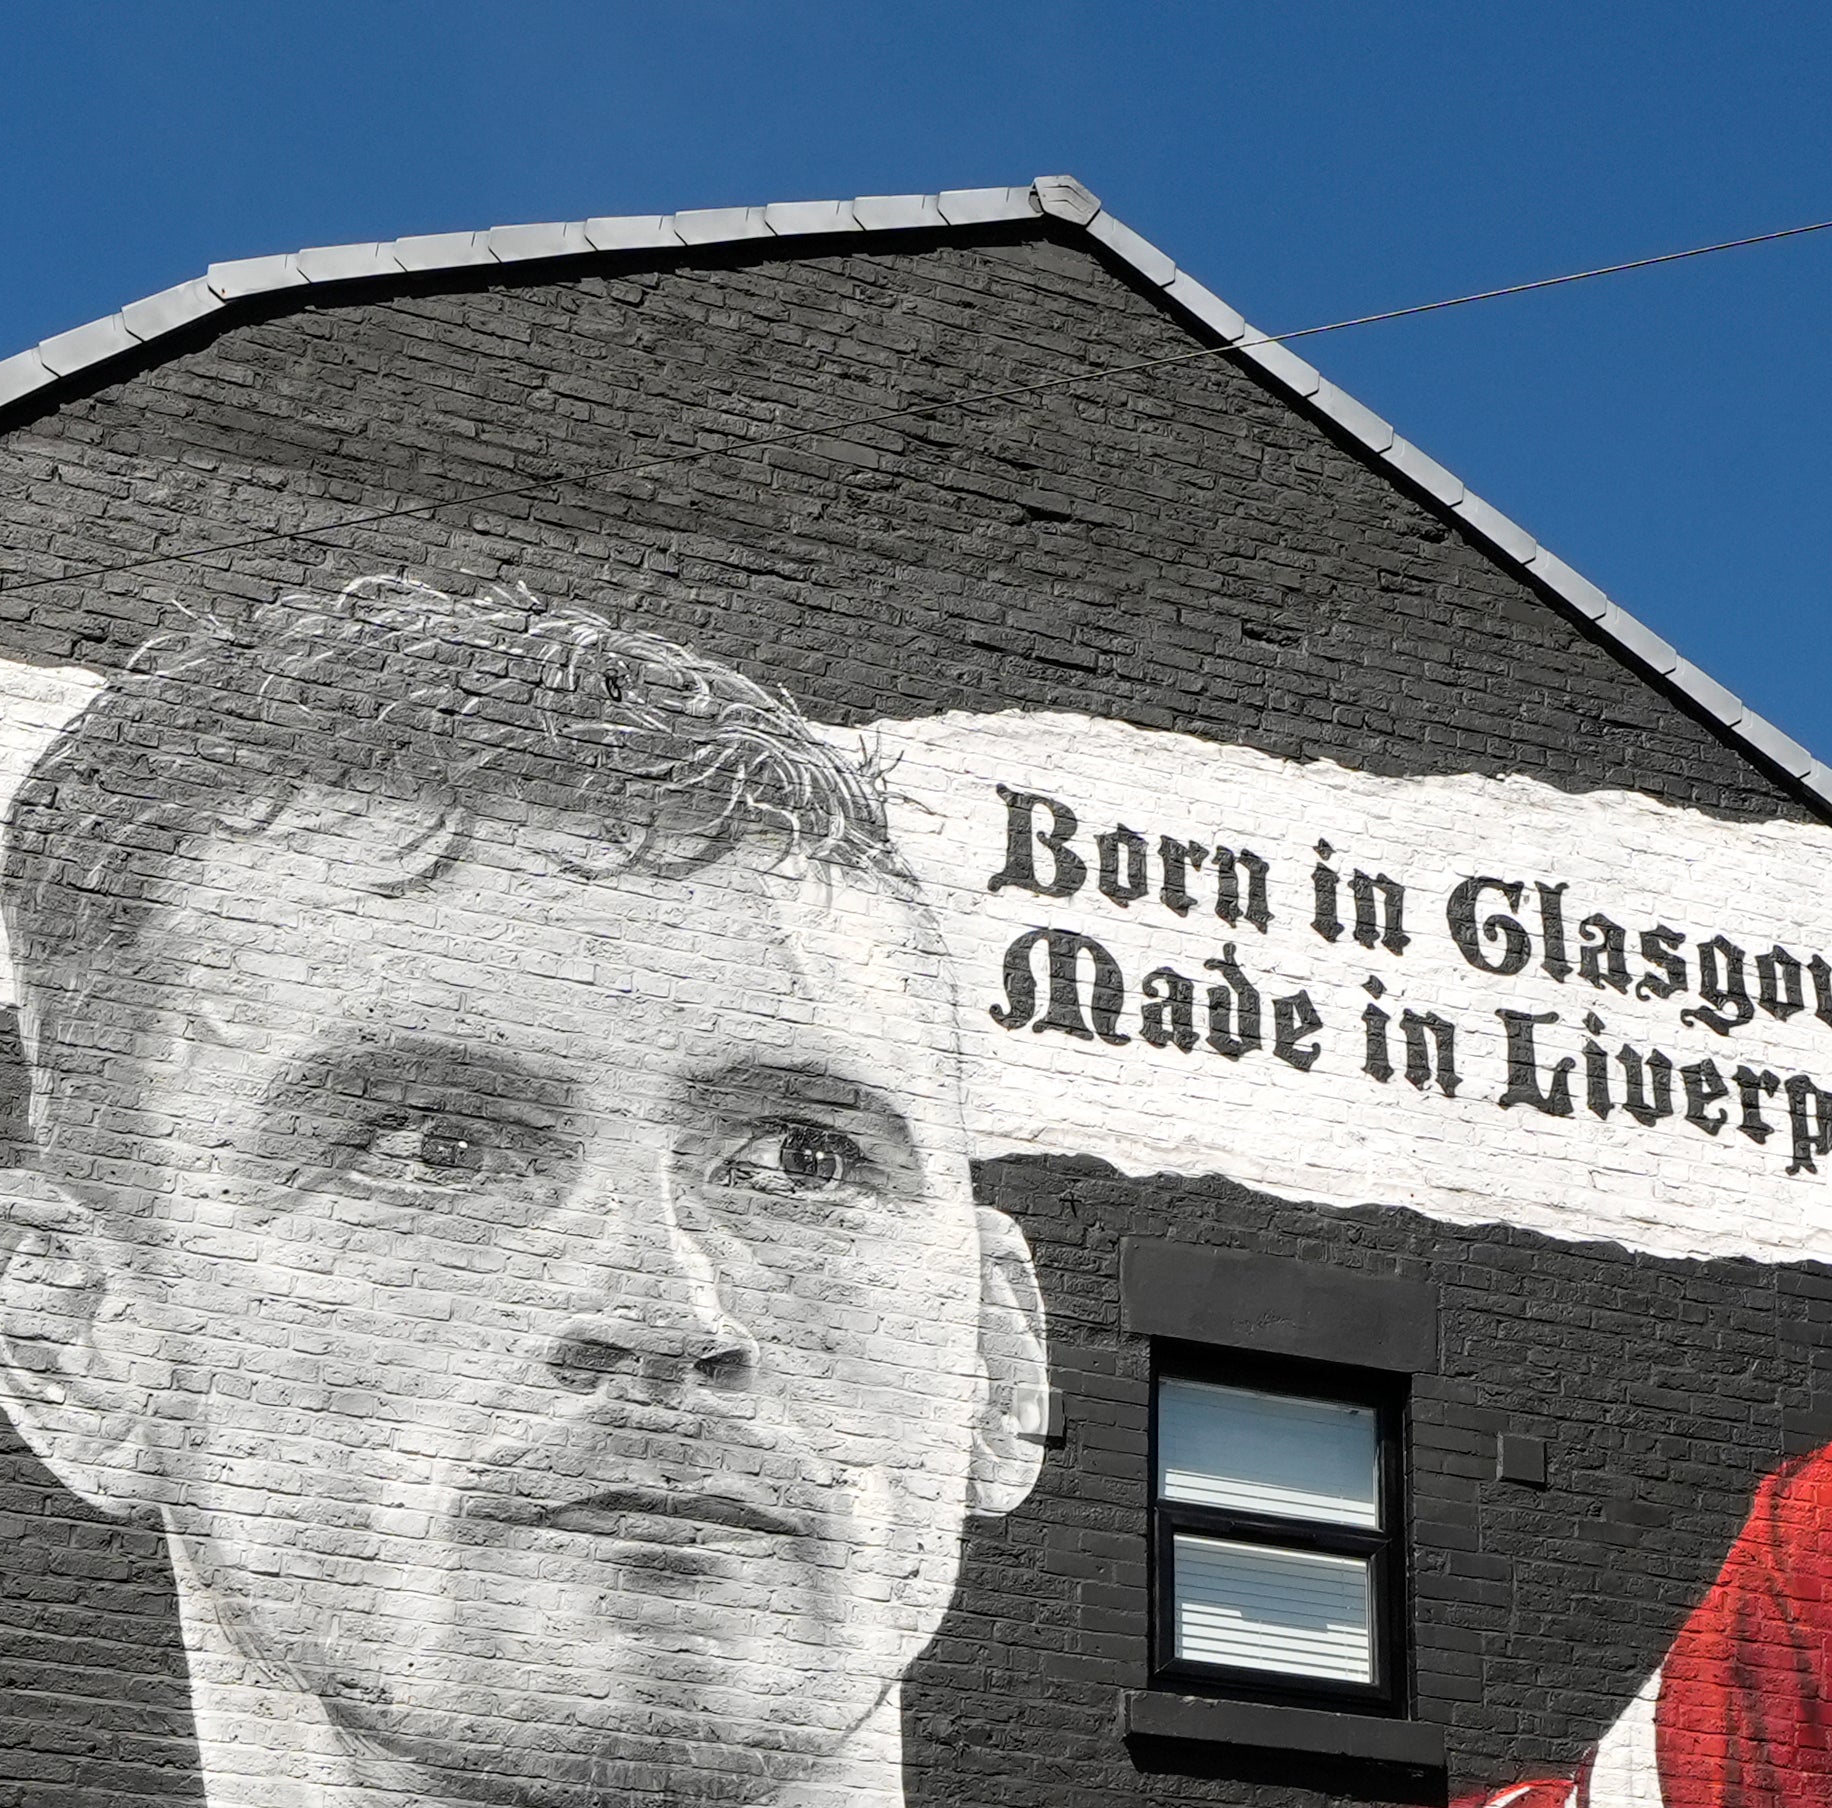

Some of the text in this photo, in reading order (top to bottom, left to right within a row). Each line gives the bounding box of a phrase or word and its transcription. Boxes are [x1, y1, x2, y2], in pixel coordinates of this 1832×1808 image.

[988, 782, 1270, 934] Born
[1310, 838, 1410, 956] in
[989, 927, 1323, 1073] Made
[1361, 975, 1462, 1097] in
